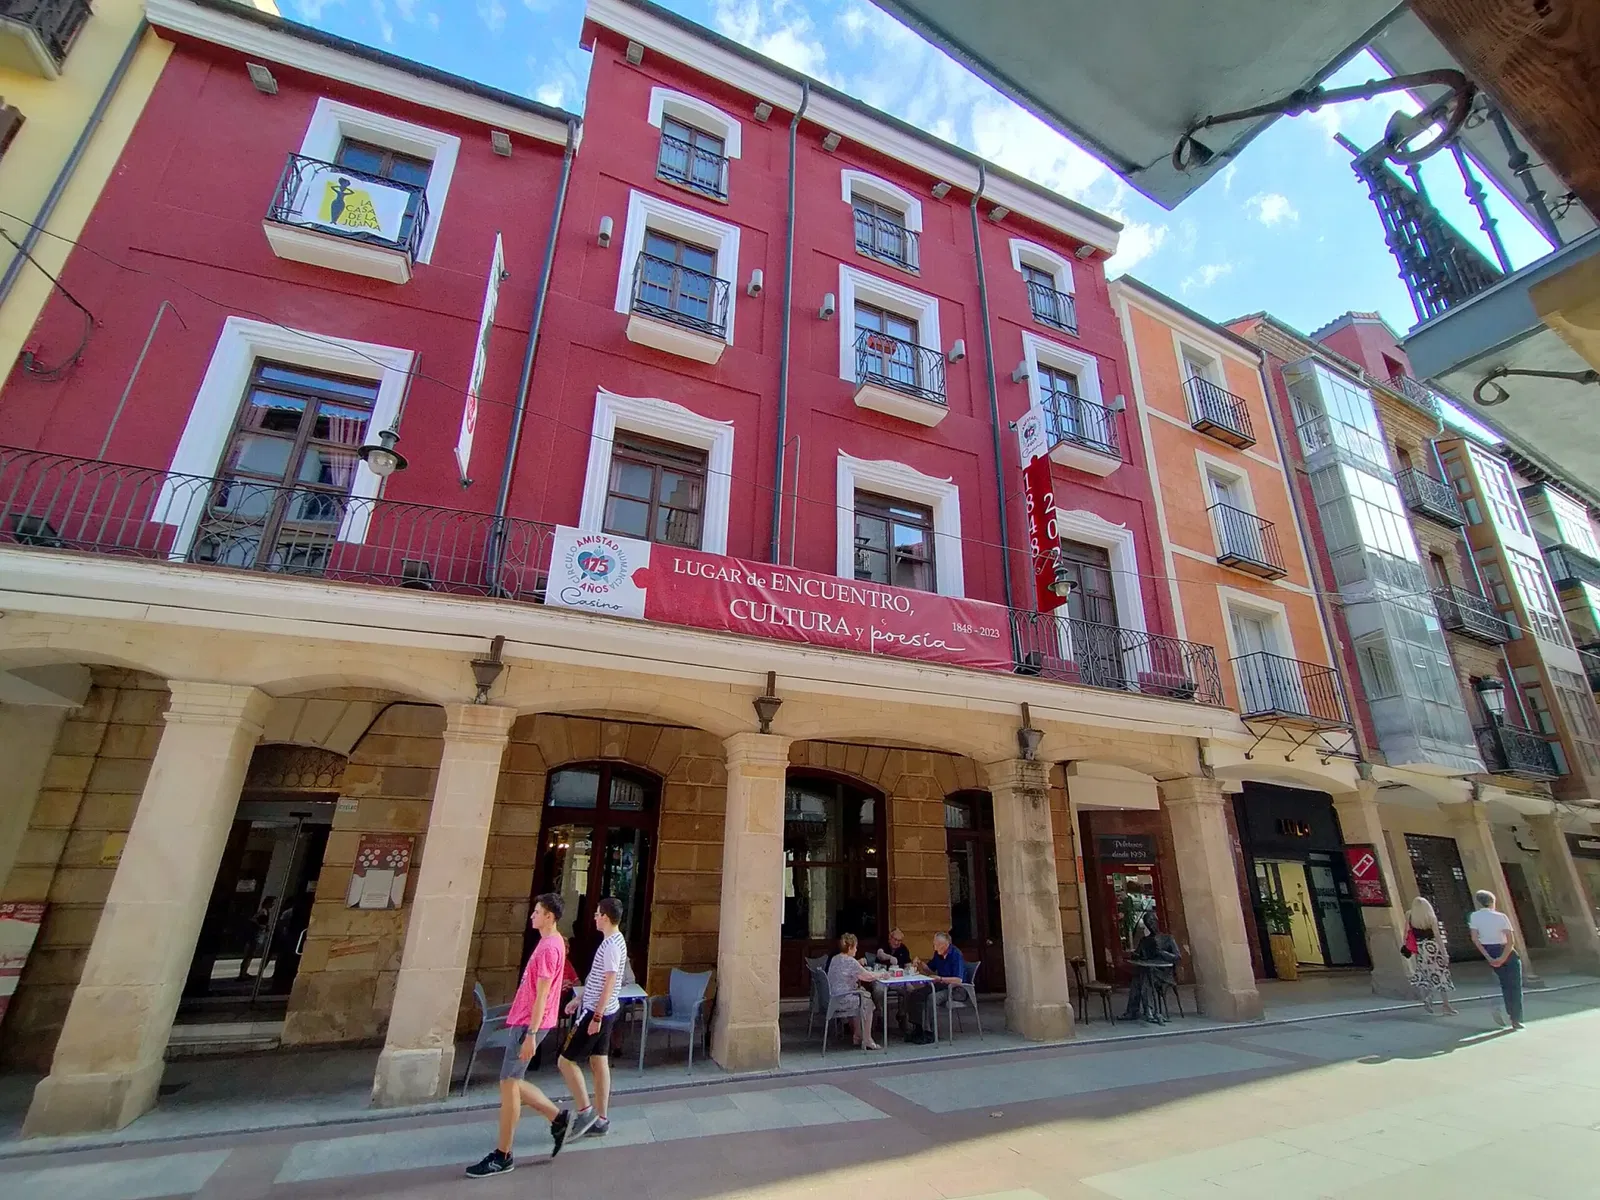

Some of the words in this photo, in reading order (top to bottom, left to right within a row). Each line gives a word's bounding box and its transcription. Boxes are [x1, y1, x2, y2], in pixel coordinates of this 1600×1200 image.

[345, 205, 376, 215] CASA
[361, 199, 372, 207] LA
[342, 219, 381, 231] JUANA
[348, 212, 362, 220] DE
[364, 214, 377, 223] LA
[576, 535, 619, 551] AMISTAD
[1043, 493, 1065, 583] 202
[582, 557, 609, 573] 175
[609, 549, 628, 590] NUMANCIA
[579, 582, 609, 594] AÑOS
[674, 558, 742, 584] LUGAR
[746, 572, 766, 588] de
[771, 572, 915, 616] ENCUENTRO,
[560, 586, 623, 611] Casino
[729, 598, 852, 636] CULTURA
[854, 627, 864, 641] y
[870, 624, 966, 654] poesía
[952, 622, 973, 634] 1848
[980, 626, 1000, 639] 2023
